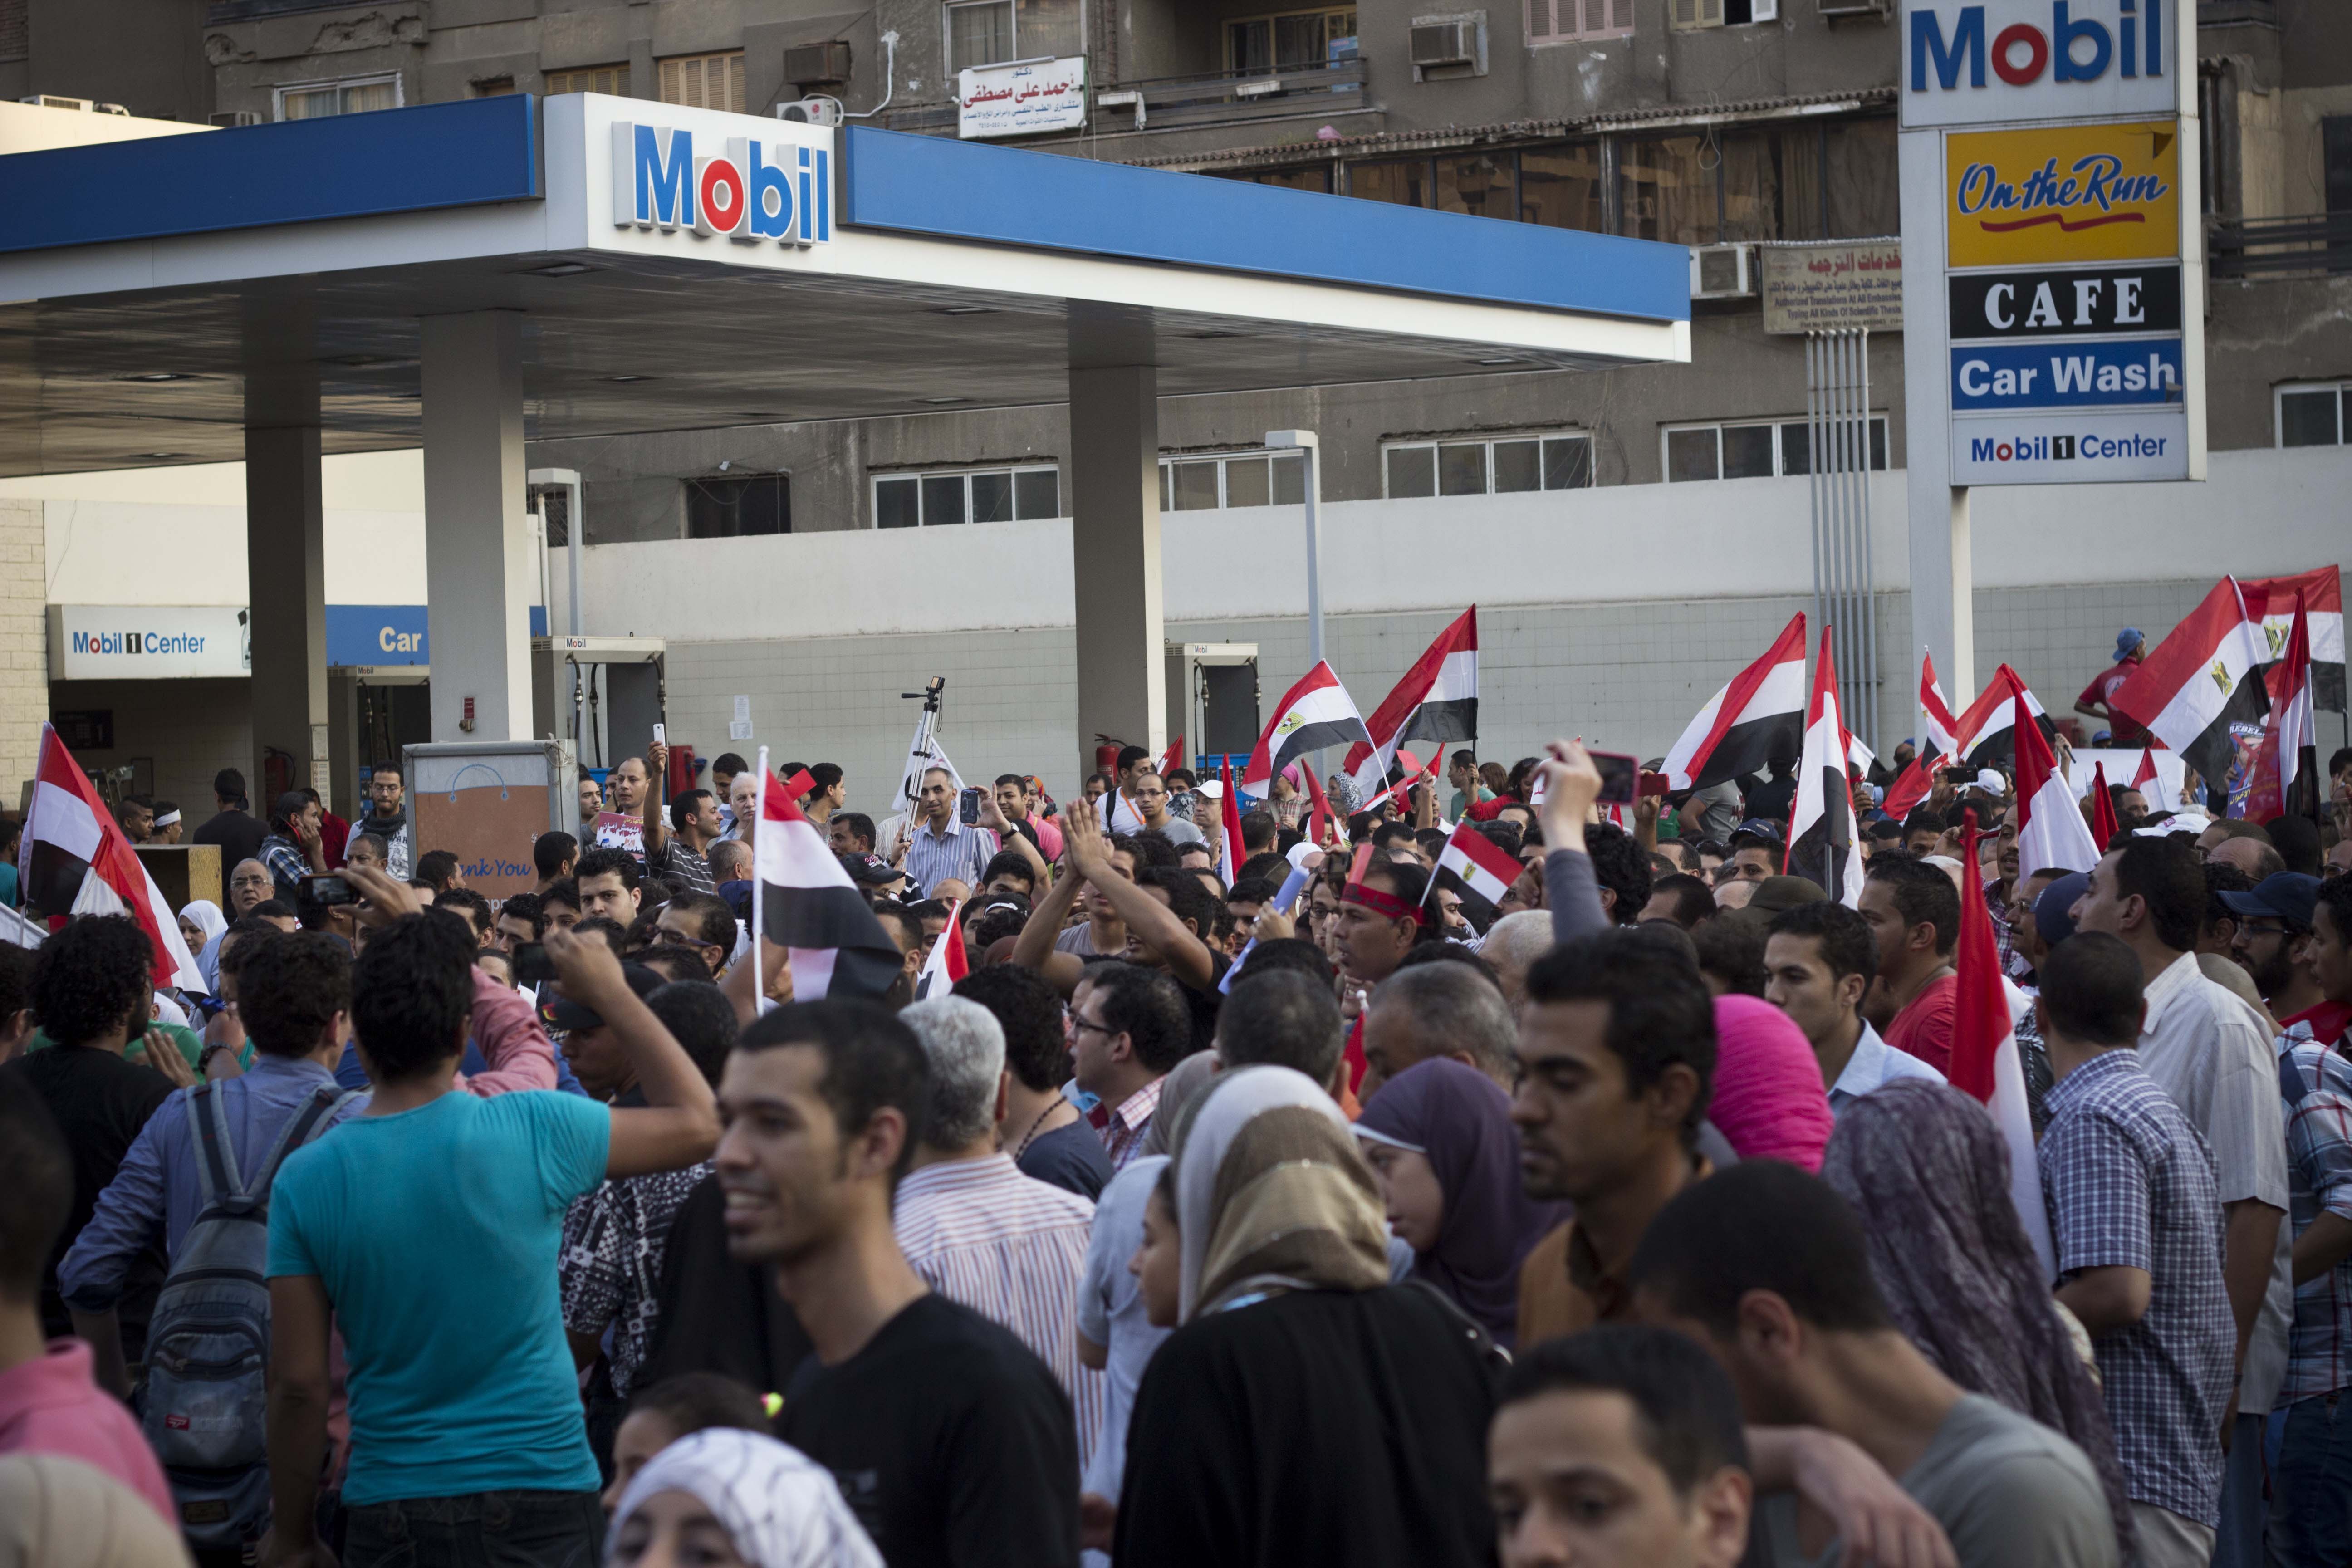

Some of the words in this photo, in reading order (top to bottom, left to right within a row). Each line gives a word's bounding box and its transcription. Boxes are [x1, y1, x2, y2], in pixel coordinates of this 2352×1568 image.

[1911, 0, 2163, 91] Mobil
[1012, 67, 1032, 79] دكتور
[633, 123, 830, 244] Mobil
[1958, 163, 2021, 214] On
[2022, 157, 2082, 211] the
[2072, 153, 2168, 213] Run
[1809, 295, 1847, 305] Translations
[1984, 276, 2145, 330] CAFE
[1787, 309, 1808, 320] Typing
[1820, 308, 1839, 317] Kinds
[1959, 359, 2038, 397] Car
[2050, 353, 2176, 394] Wash
[1971, 436, 2048, 462] Mobil
[2080, 433, 2166, 459] Center
[73, 632, 122, 654] Mobil
[144, 632, 205, 654] Center
[379, 626, 422, 652] Car
[566, 638, 586, 648] Mobil
[458, 858, 494, 877] ank
[494, 859, 532, 877] You
